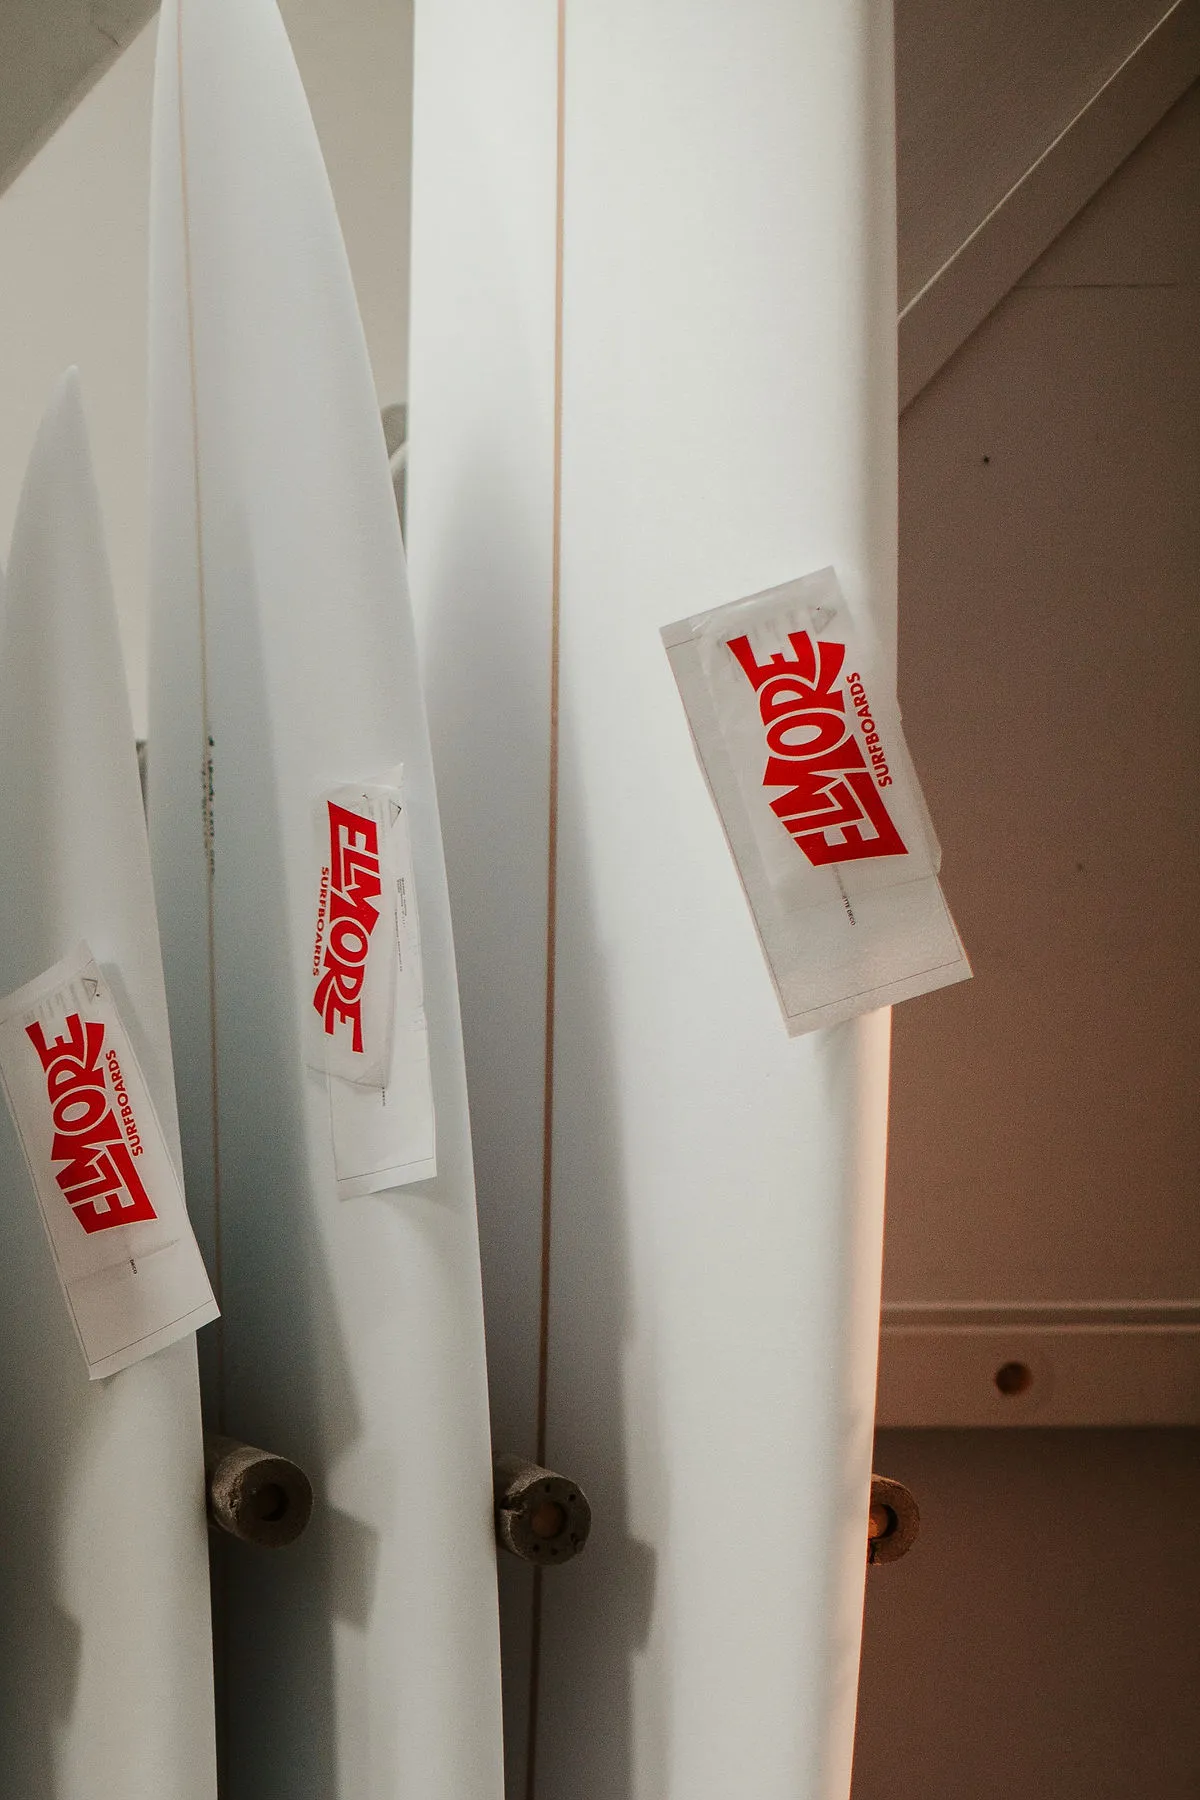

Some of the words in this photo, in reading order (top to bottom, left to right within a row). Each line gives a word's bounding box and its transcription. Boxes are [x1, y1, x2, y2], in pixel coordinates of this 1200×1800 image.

[726, 630, 908, 867] ELMORE
[846, 672, 893, 788] SURFBOARDS
[312, 867, 330, 977] SURFBOARDS
[313, 801, 382, 1053] ELMORE
[25, 1013, 158, 1235] ELMORE
[105, 1048, 144, 1157] SURFBOARDS
